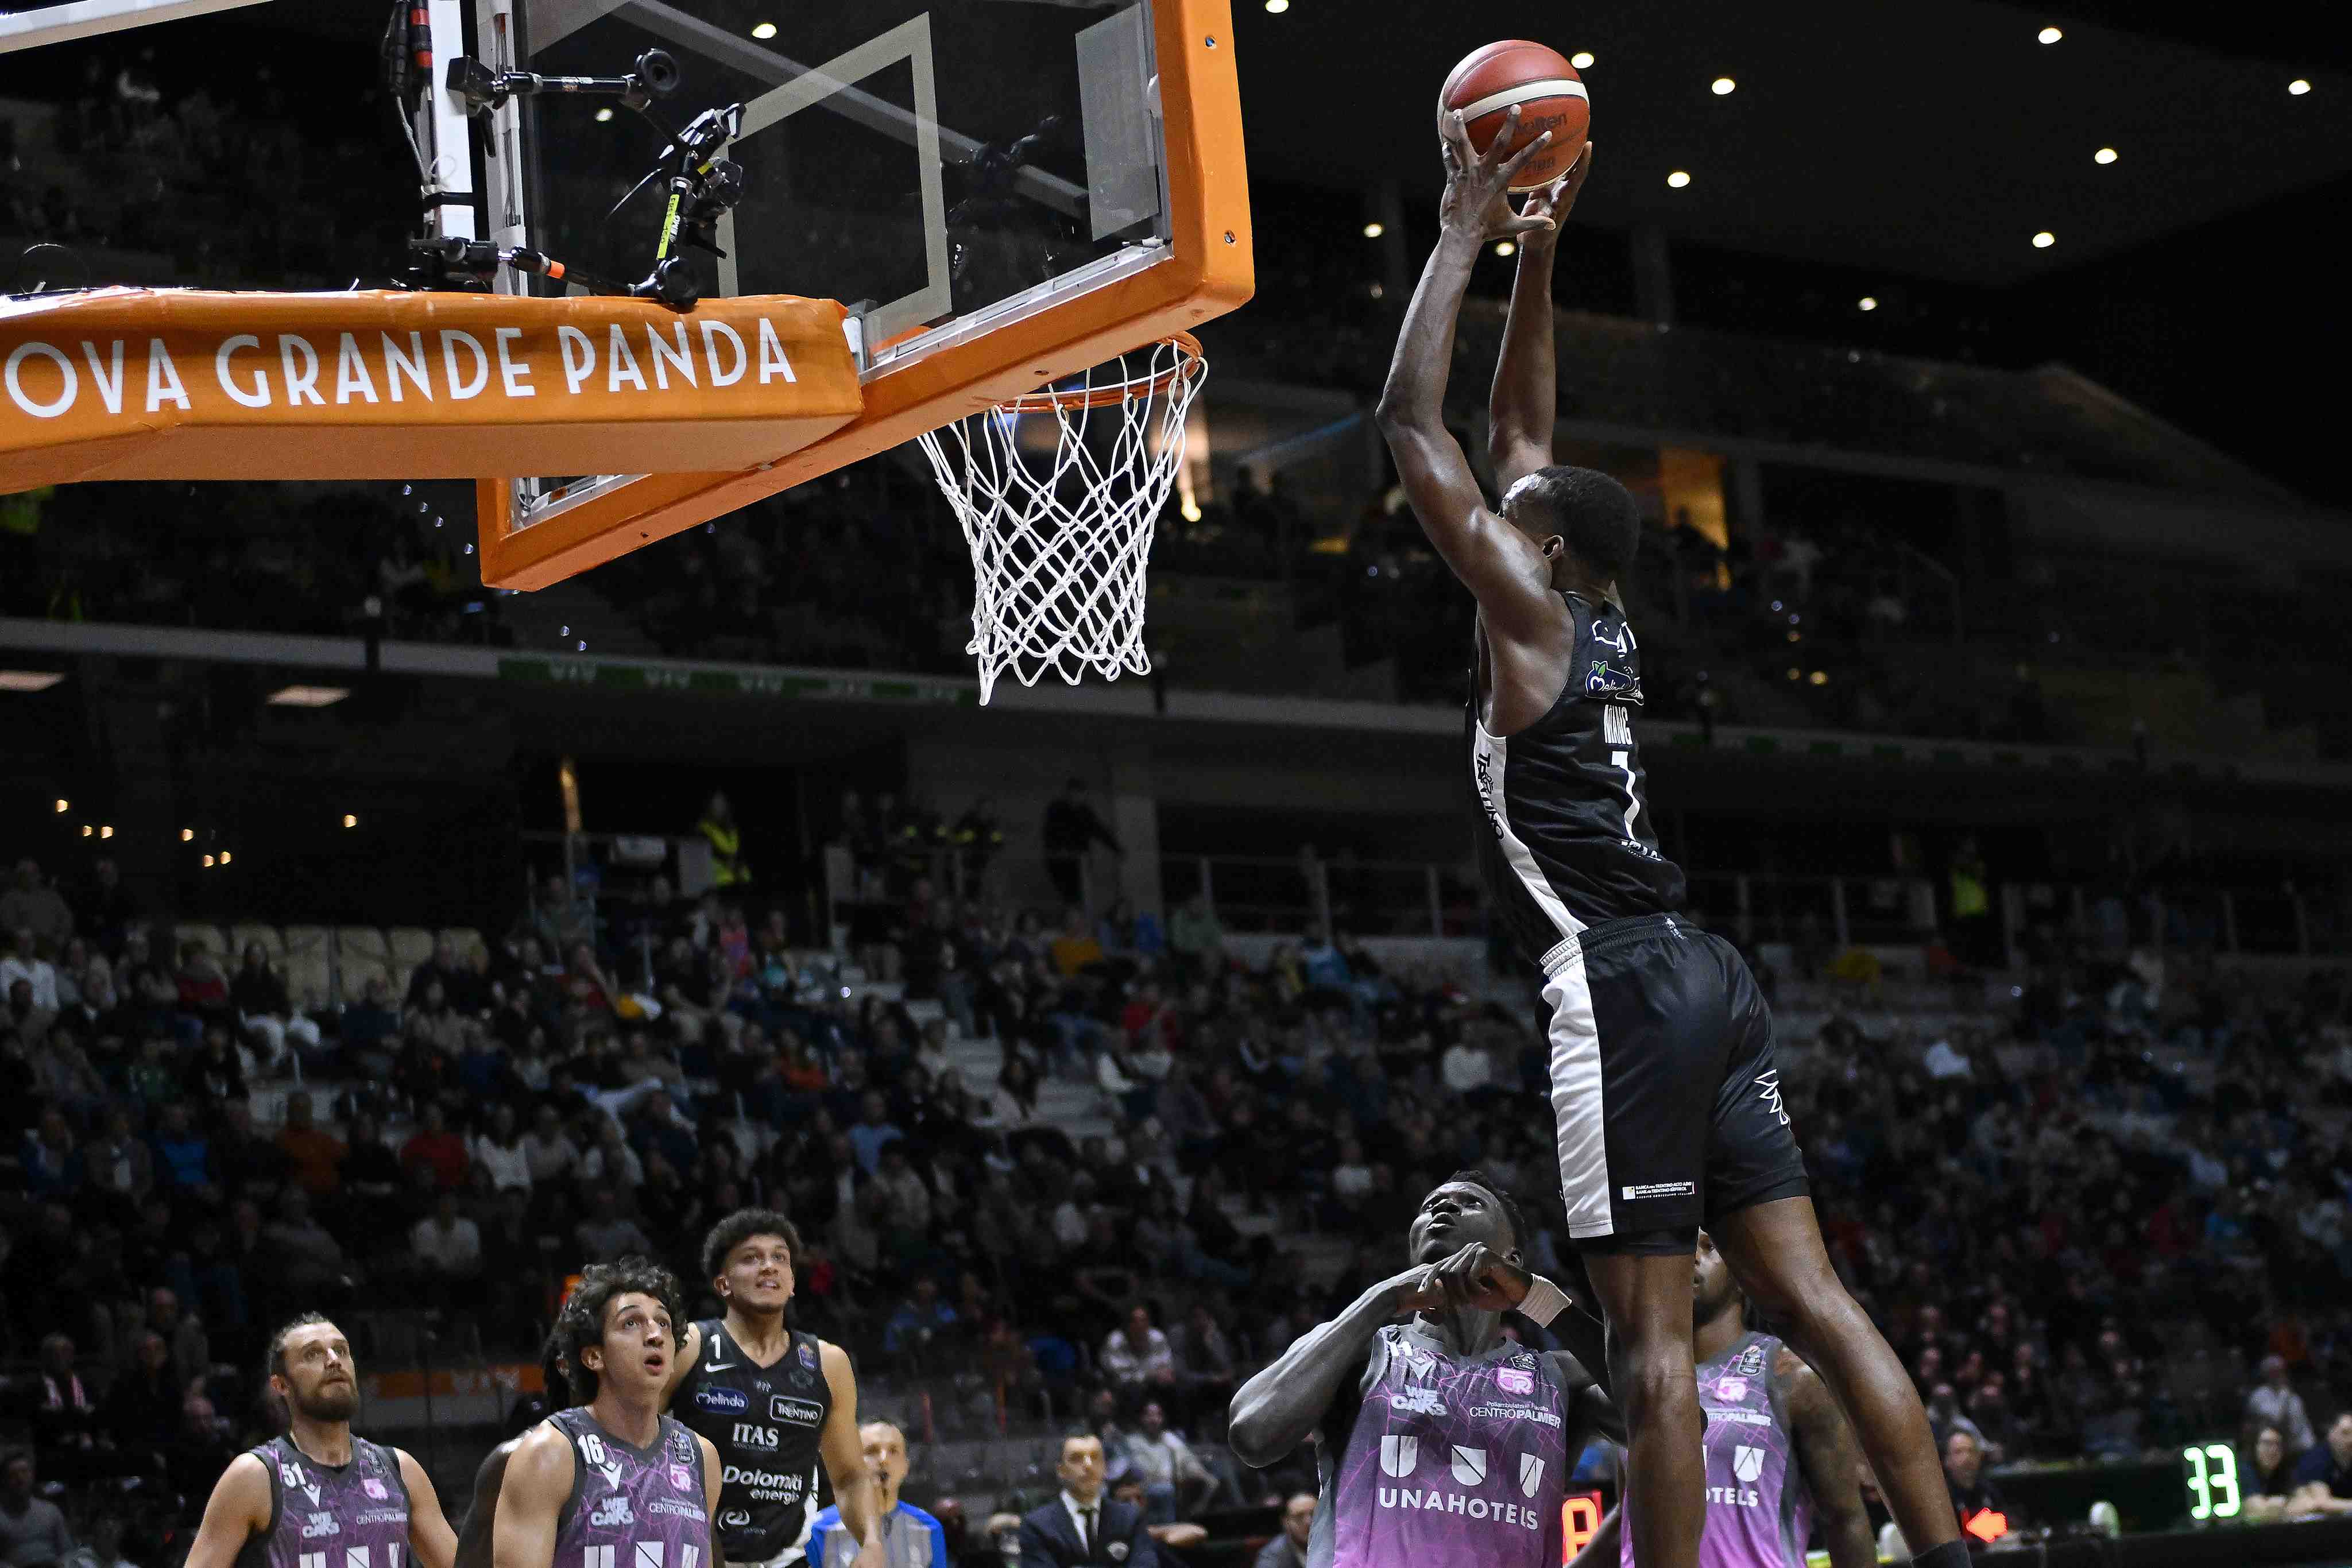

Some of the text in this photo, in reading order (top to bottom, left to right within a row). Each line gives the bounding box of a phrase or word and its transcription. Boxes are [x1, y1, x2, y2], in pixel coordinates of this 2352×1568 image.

[215, 326, 536, 409] GRANDE
[558, 318, 798, 394] PANDA
[710, 1333, 722, 1360] 1
[1469, 1406, 1561, 1428] CENTROPALMER
[732, 1423, 779, 1447] ITAS
[578, 1434, 606, 1464] 16
[281, 1462, 305, 1488] 51
[2184, 1444, 2241, 1520] 33
[1379, 1487, 1539, 1530] UNAHOTELS
[1706, 1487, 1758, 1507] TELS
